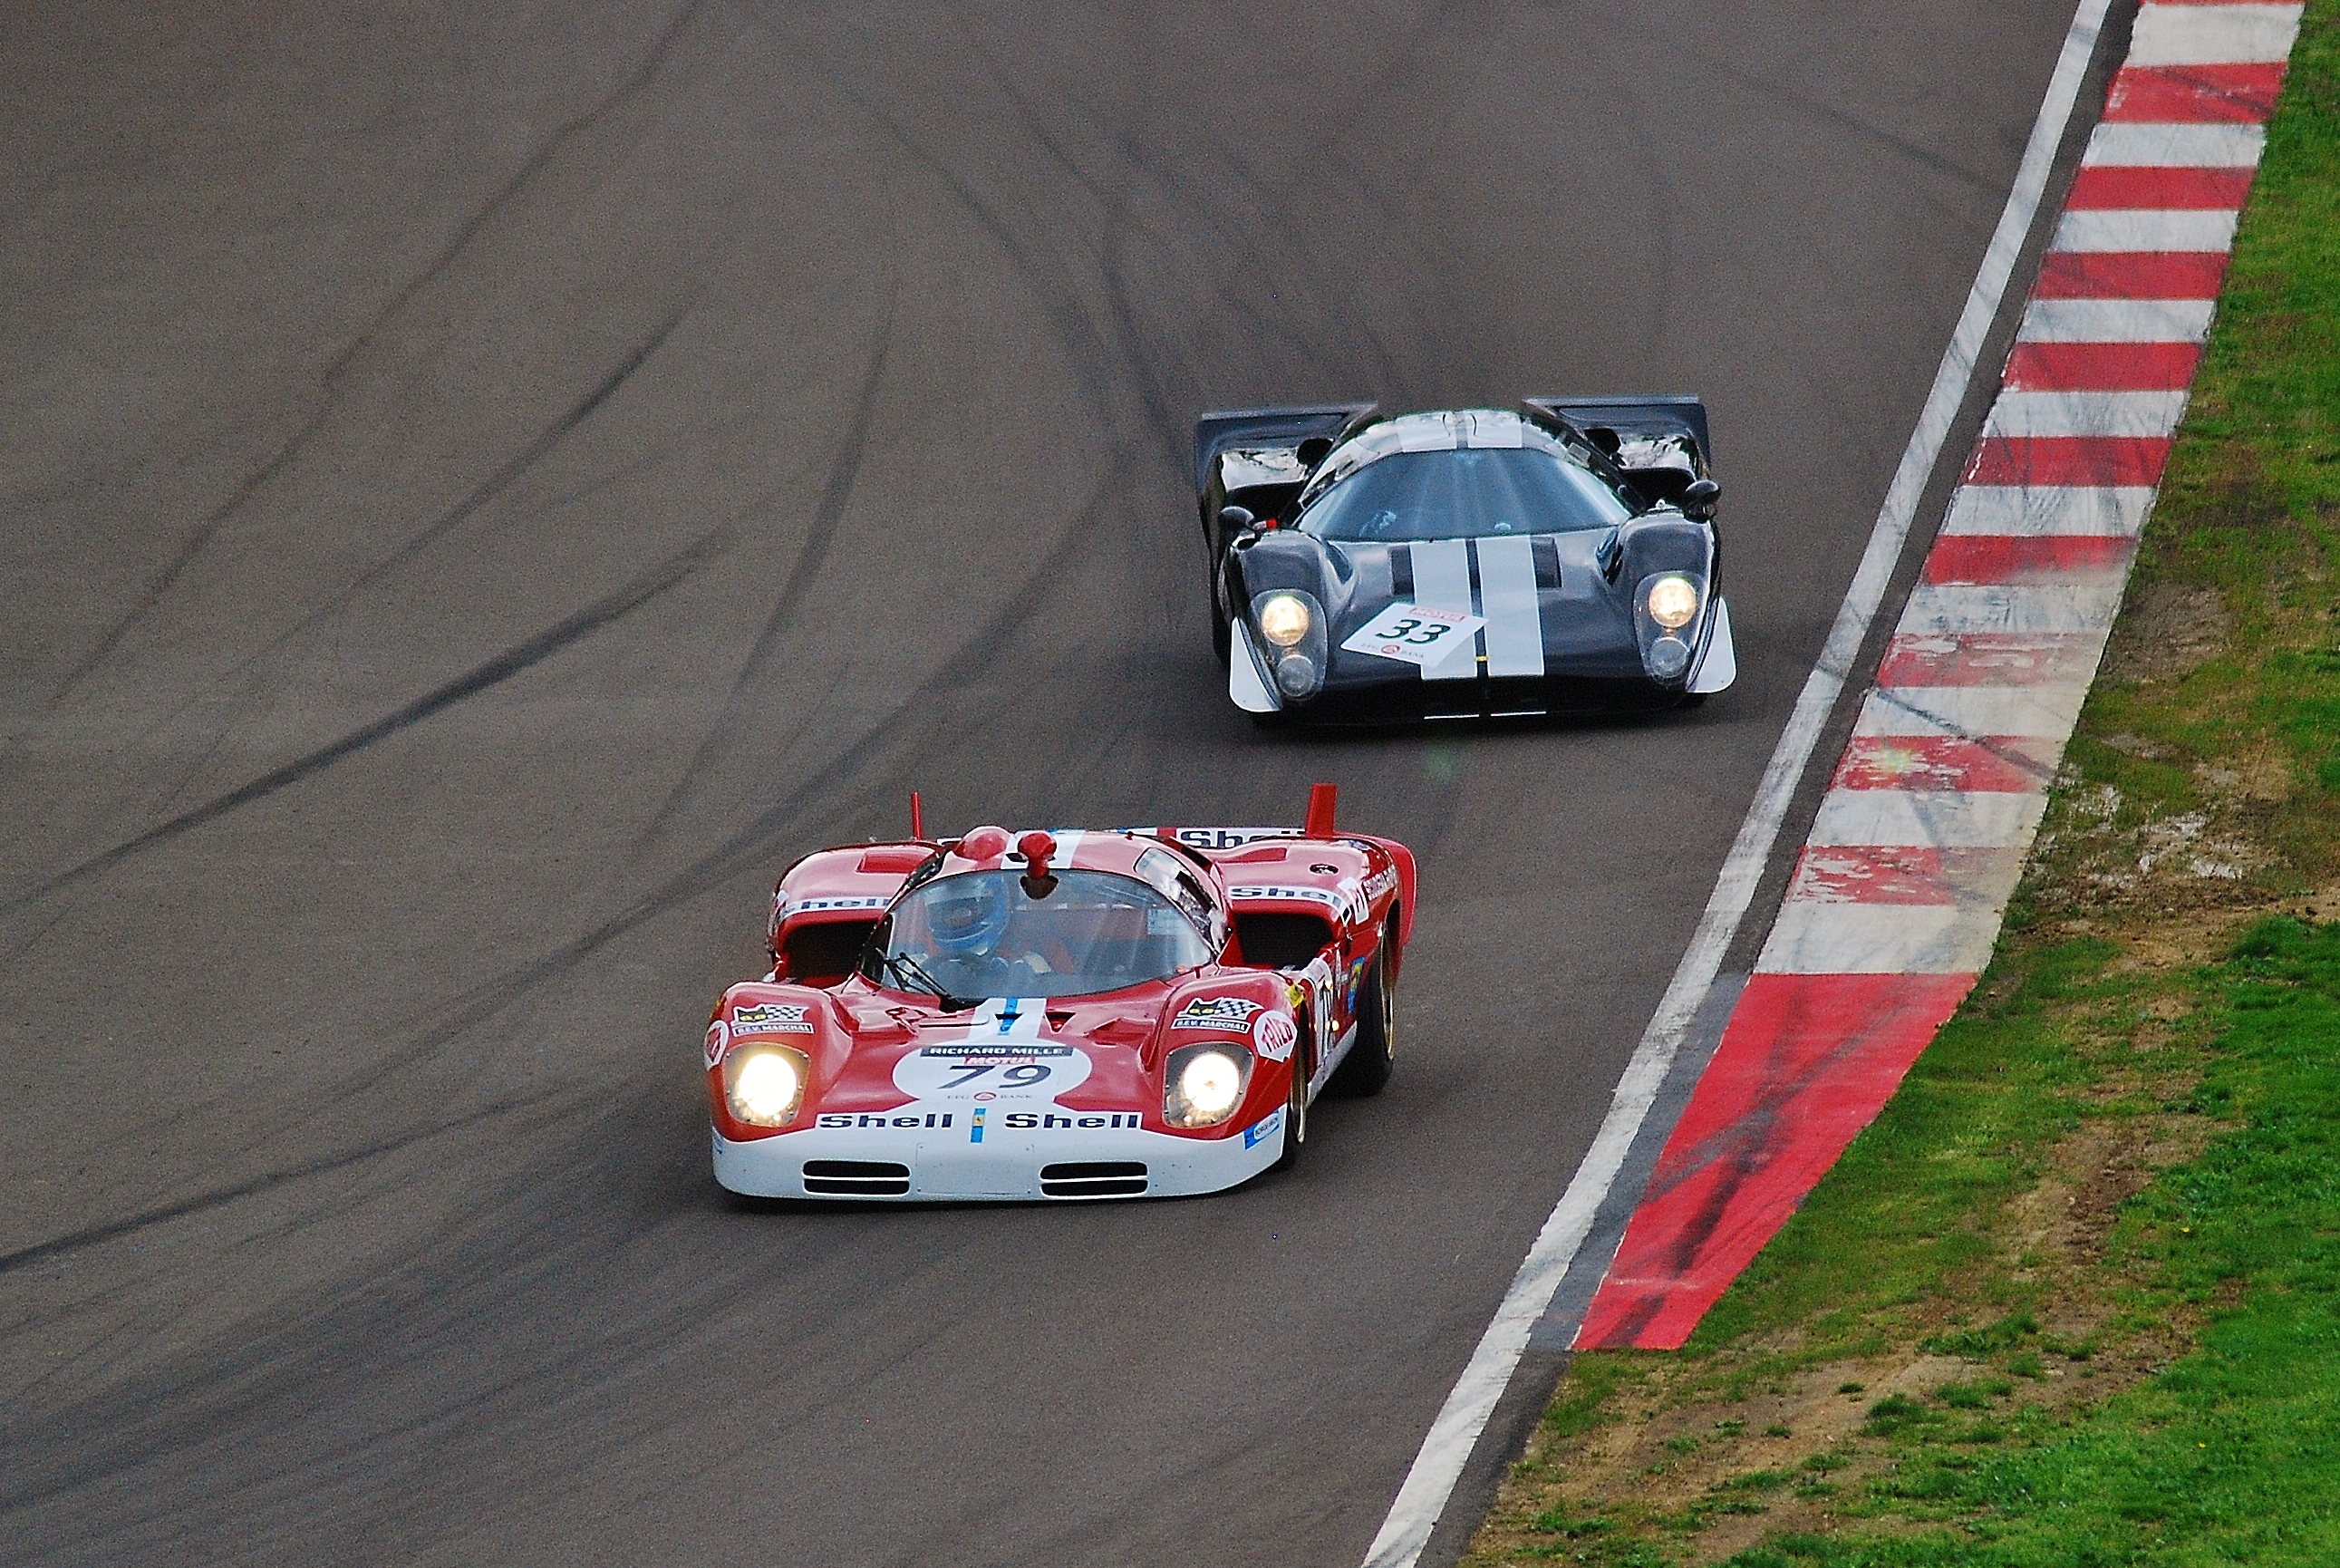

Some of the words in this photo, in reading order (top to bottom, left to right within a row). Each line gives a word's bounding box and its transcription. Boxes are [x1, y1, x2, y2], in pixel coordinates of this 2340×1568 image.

[1375, 619, 1450, 644] 33
[1199, 1021, 1245, 1031] MARCHAL
[930, 1047, 1001, 1055] RICHARD
[1011, 1047, 1063, 1055] MILLE
[966, 1057, 1034, 1065] MOTUL
[938, 1065, 1051, 1089] 79
[819, 1113, 952, 1128] Shell
[1005, 1113, 1138, 1128] Shell
